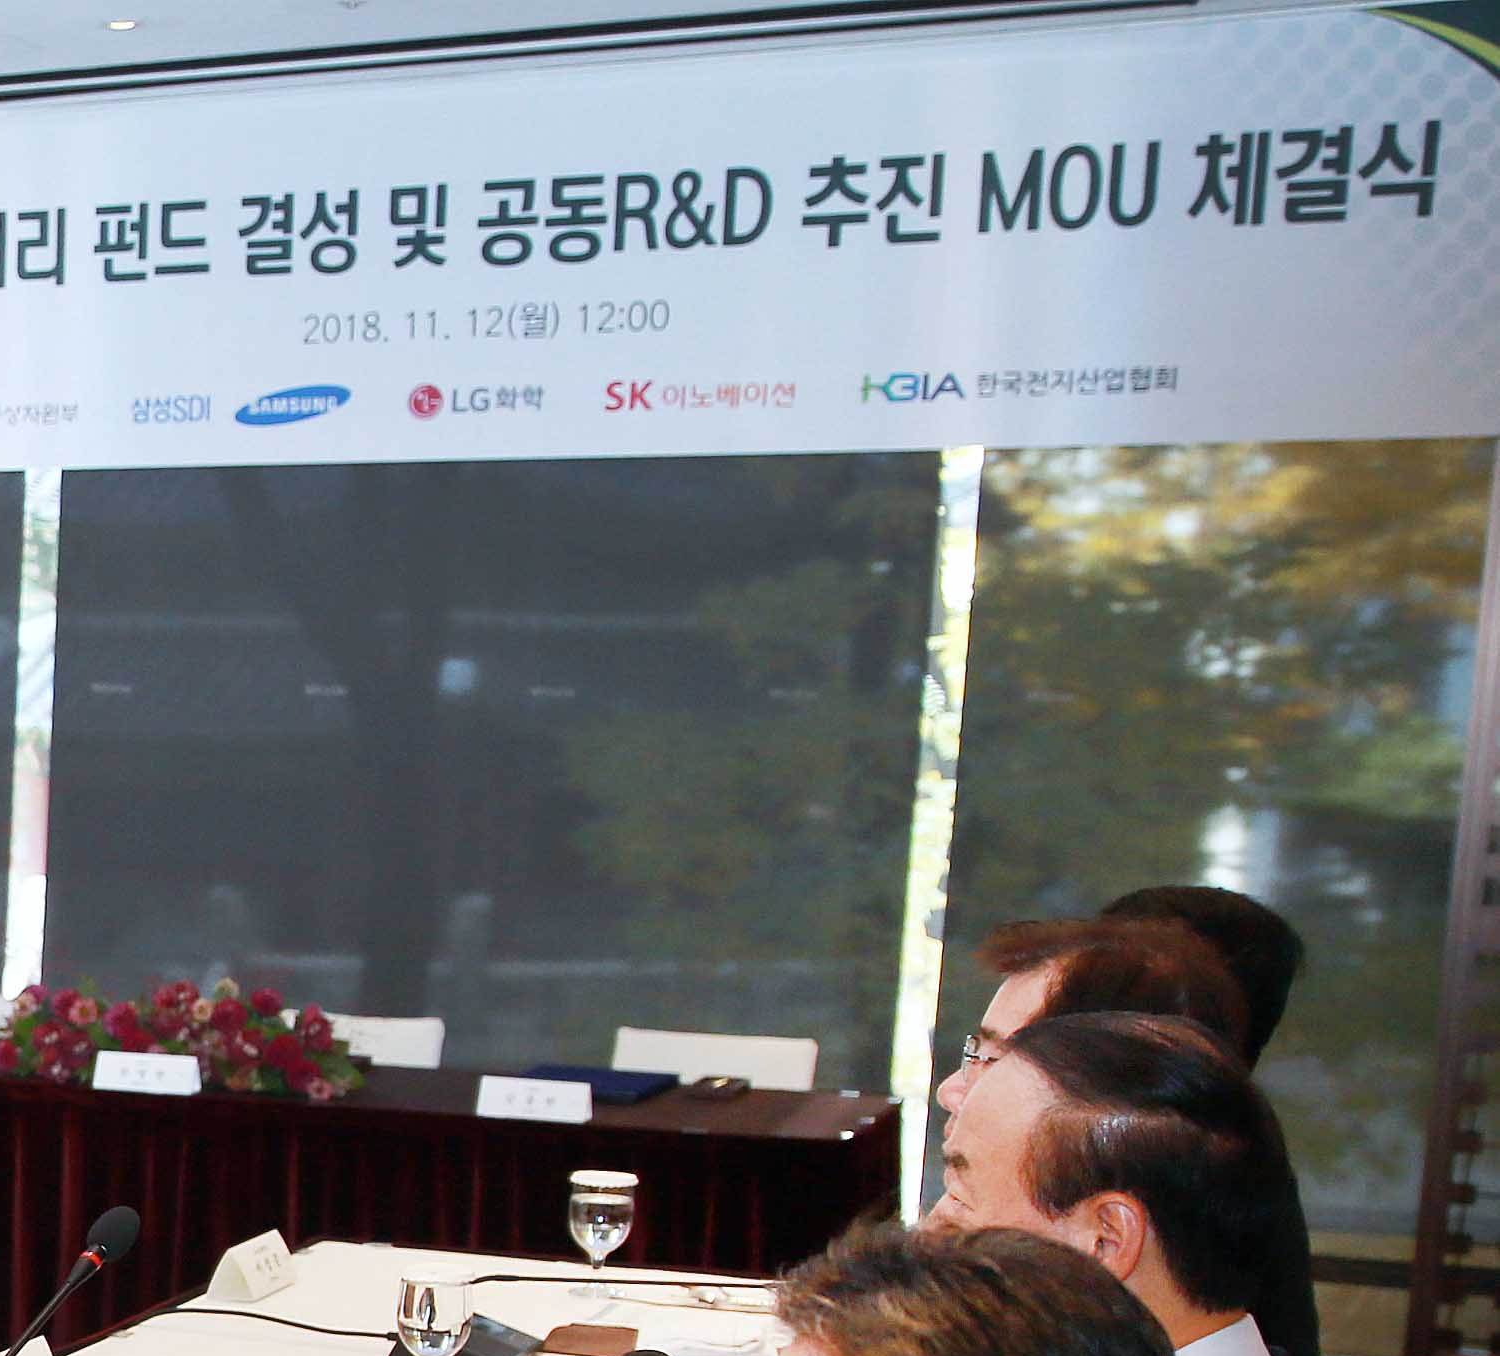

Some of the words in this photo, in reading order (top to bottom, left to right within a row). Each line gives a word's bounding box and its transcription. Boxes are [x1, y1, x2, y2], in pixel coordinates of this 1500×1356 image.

[93, 199, 211, 283] 펀드
[238, 188, 360, 277] 결성
[389, 182, 448, 269] 및
[477, 167, 774, 266] 공동R&D
[801, 152, 946, 249] 추진
[977, 140, 1162, 234] MOU
[1187, 119, 1442, 228] 체결식
[302, 311, 389, 345] 2018.
[406, 309, 451, 341] 11.
[467, 301, 561, 340] 12(월)
[579, 298, 671, 334] 12:00
[976, 366, 1179, 398] 한국전지산업협회
[131, 394, 216, 424] 삼성SDI
[248, 394, 339, 416] SAMSUNG
